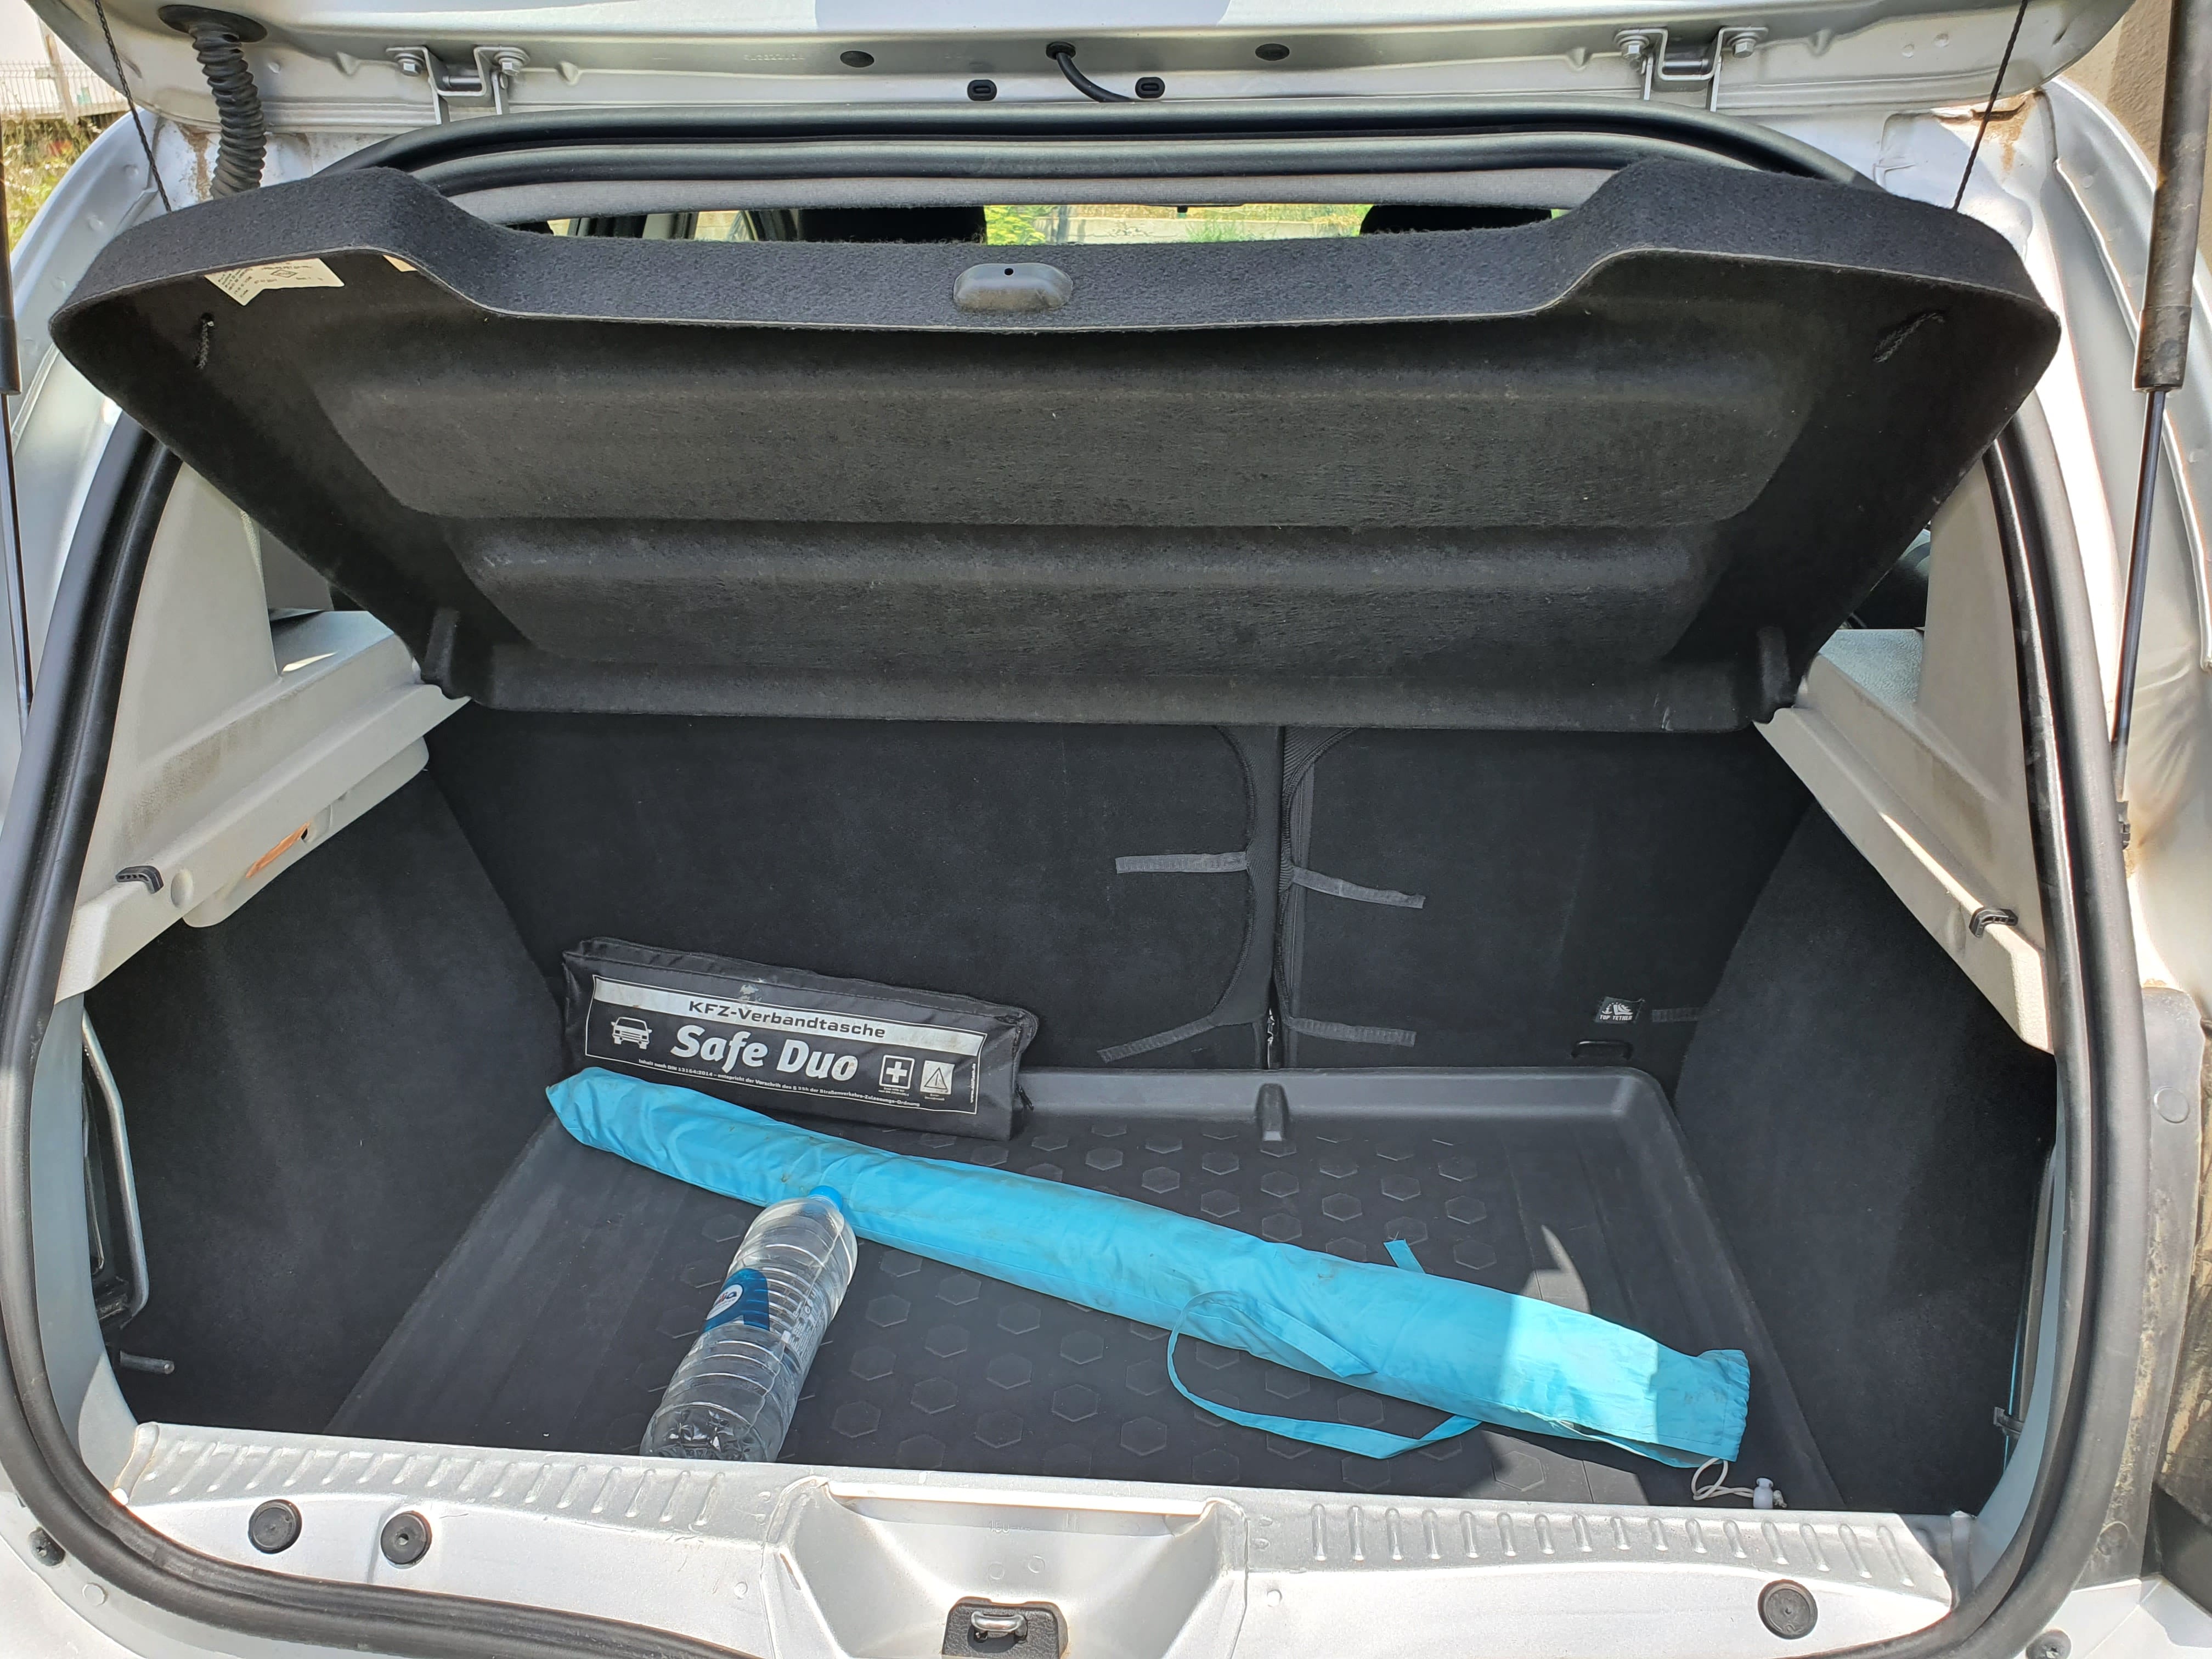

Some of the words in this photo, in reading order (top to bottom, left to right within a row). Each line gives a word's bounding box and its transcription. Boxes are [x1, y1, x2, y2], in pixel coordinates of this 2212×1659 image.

[689, 1000, 885, 1038] KFZ-Verbandtasche
[670, 1024, 768, 1073] Safe
[776, 1039, 859, 1081] Duo
[678, 1067, 713, 1076] 13164:2014
[755, 1079, 781, 1088] Vorschrift
